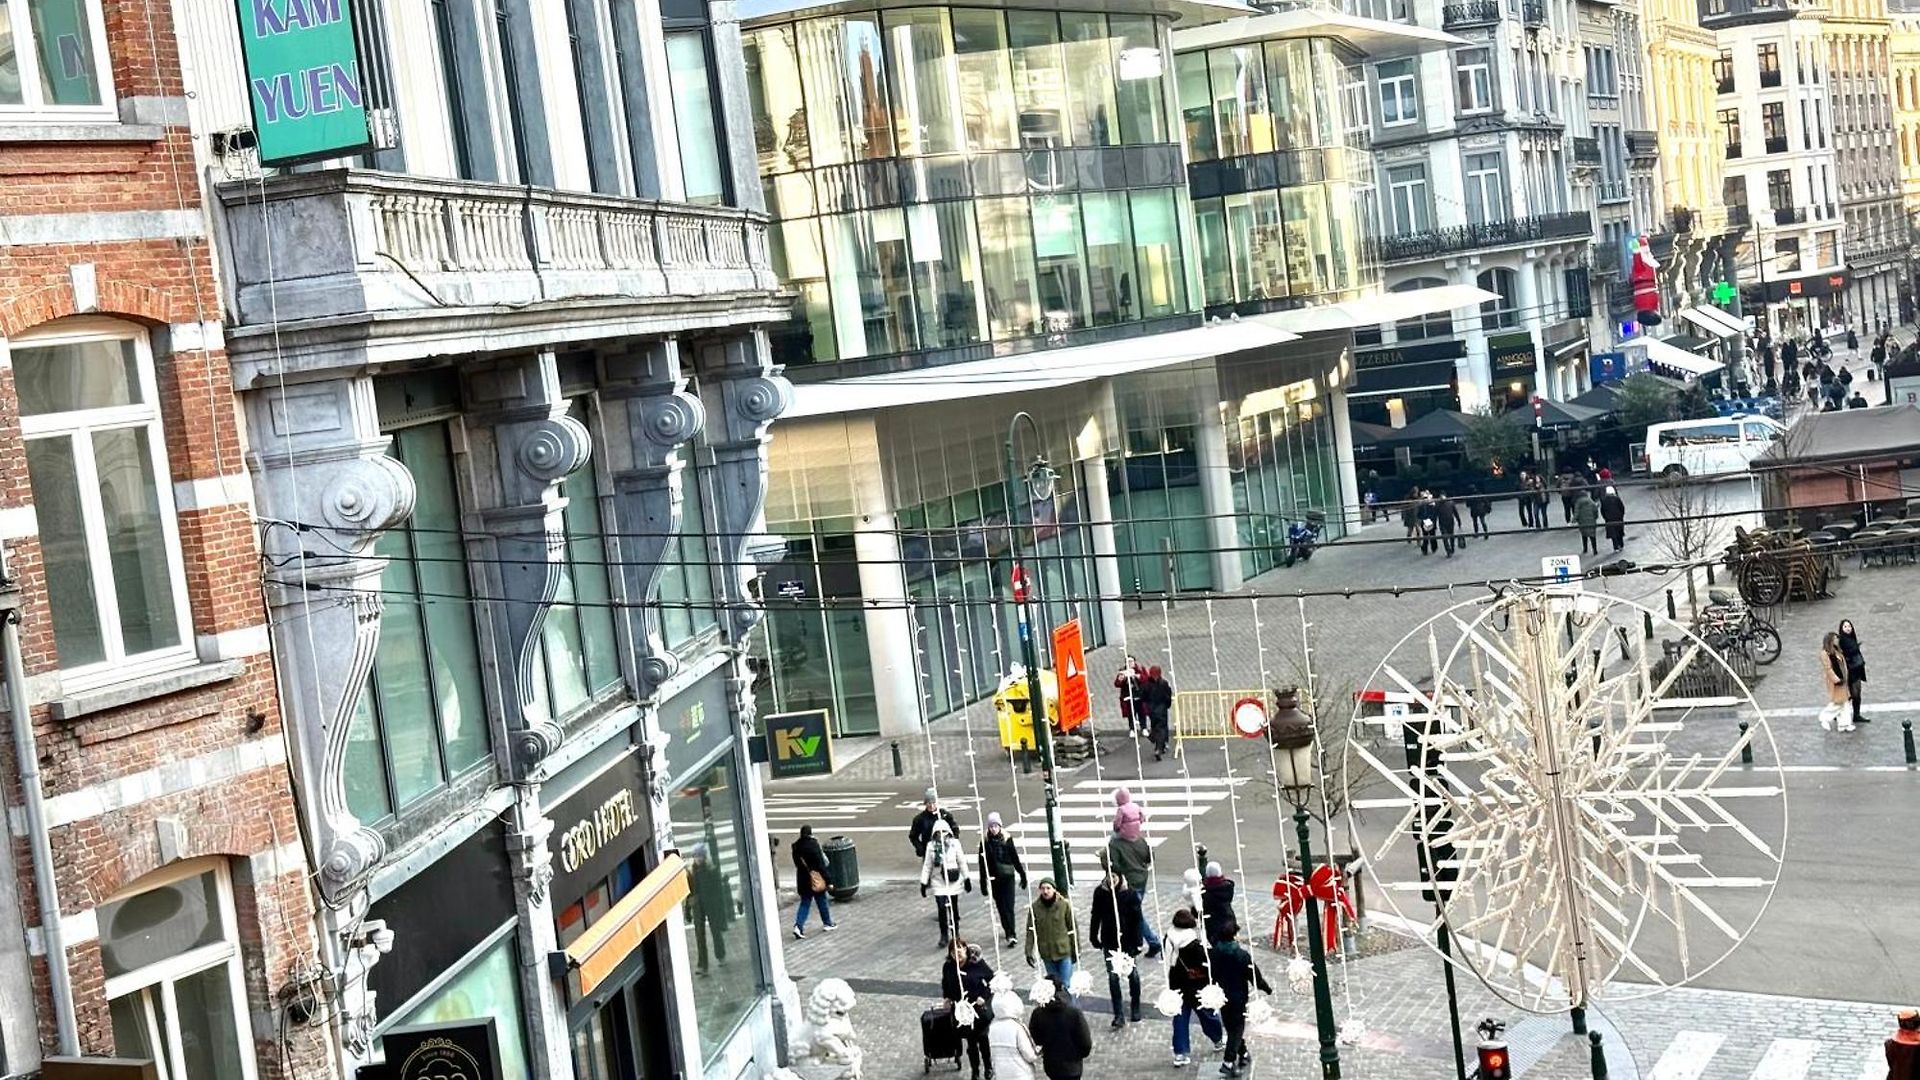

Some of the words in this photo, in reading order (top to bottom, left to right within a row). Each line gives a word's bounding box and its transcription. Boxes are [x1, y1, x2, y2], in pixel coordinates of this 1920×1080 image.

[252, 0, 343, 38] KAM
[251, 60, 363, 124] YUEN
[1550, 558, 1571, 566] ZONE
[594, 788, 639, 848] HOTEL
